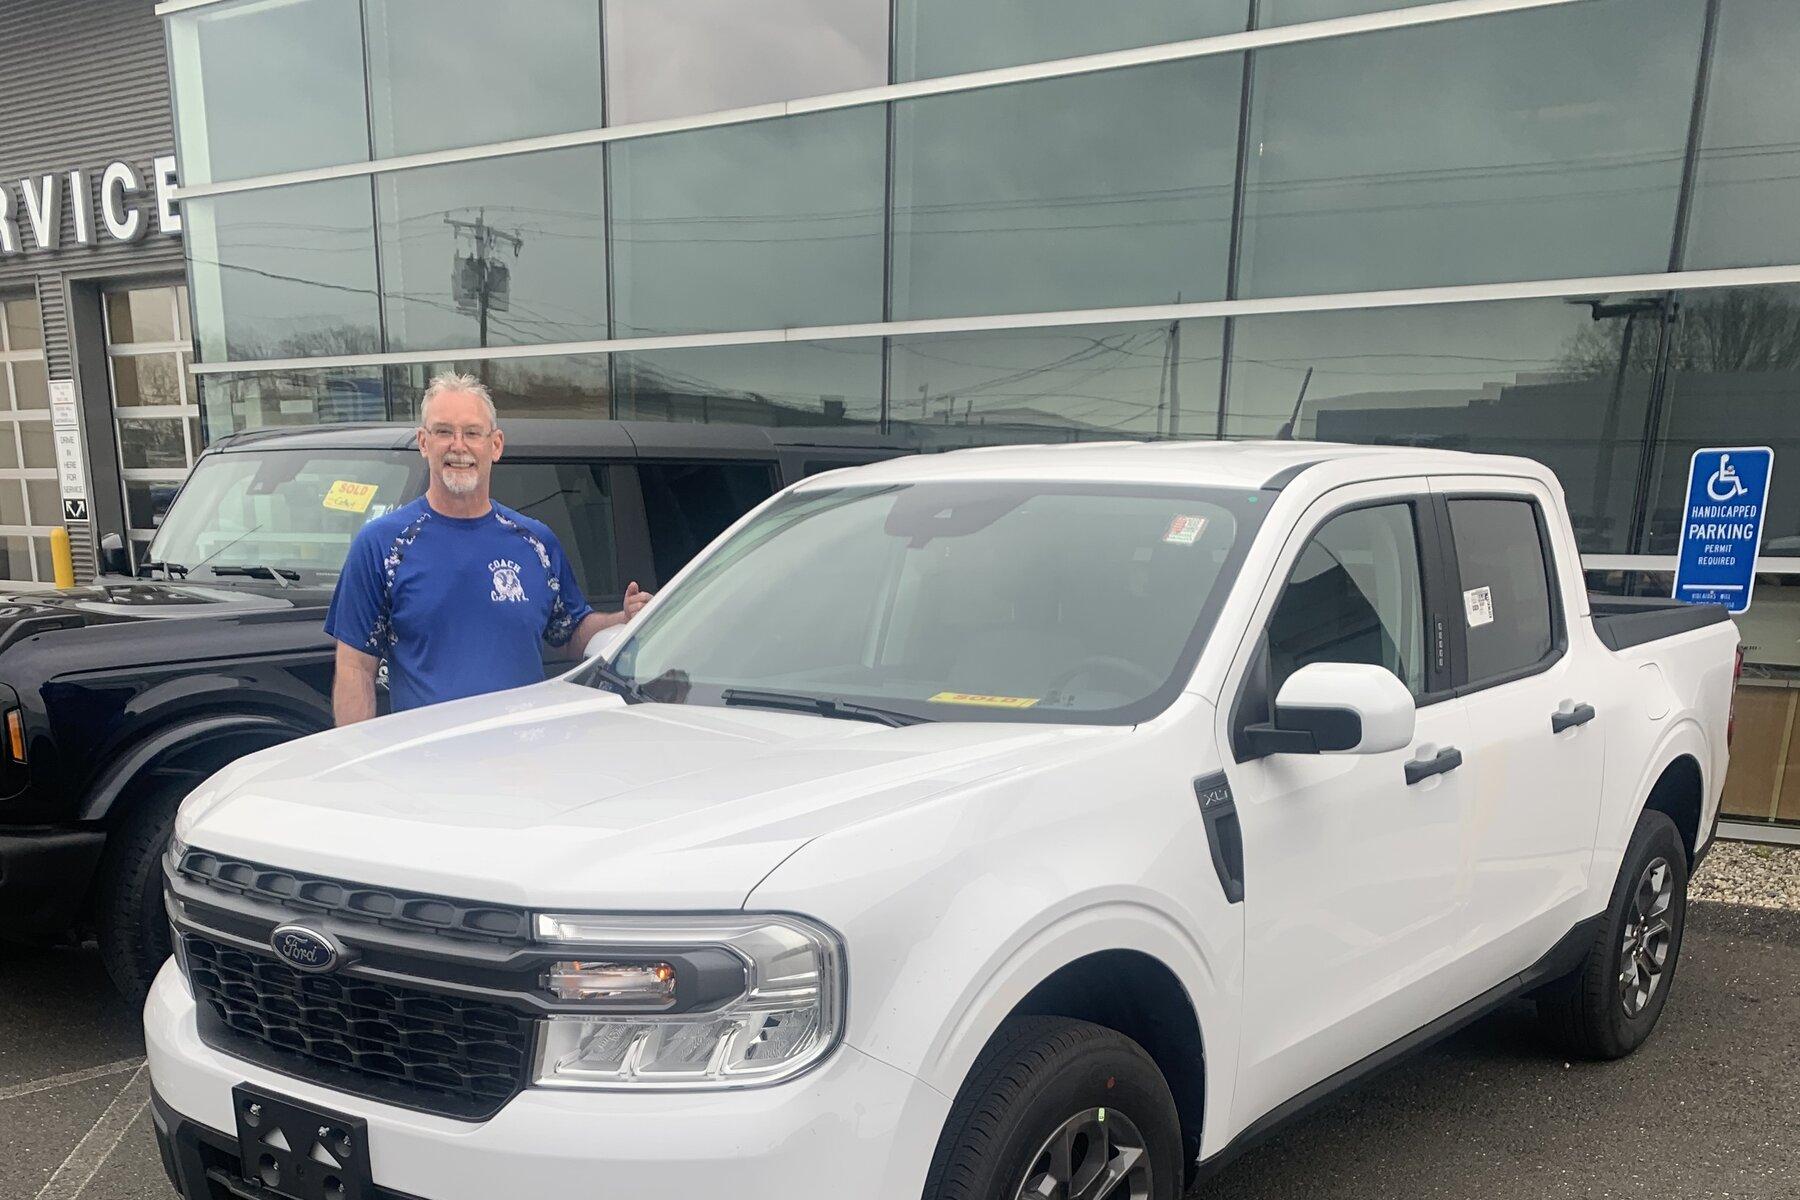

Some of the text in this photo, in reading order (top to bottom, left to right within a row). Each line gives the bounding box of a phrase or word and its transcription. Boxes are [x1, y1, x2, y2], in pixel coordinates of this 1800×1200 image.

[64, 461, 77, 469] HERE
[66, 473, 77, 481] FOR
[64, 485, 83, 494] SERVICE
[339, 482, 369, 496] SOLD
[1691, 505, 1757, 518] HANDICAPPED
[1688, 523, 1754, 540] PARKING
[1704, 544, 1733, 553] PERMIT
[488, 558, 521, 574] COACH
[1697, 556, 1736, 566] REQUIRED
[953, 694, 1018, 704] SOLD
[1203, 787, 1231, 806] XLT
[283, 934, 318, 962] Ford
